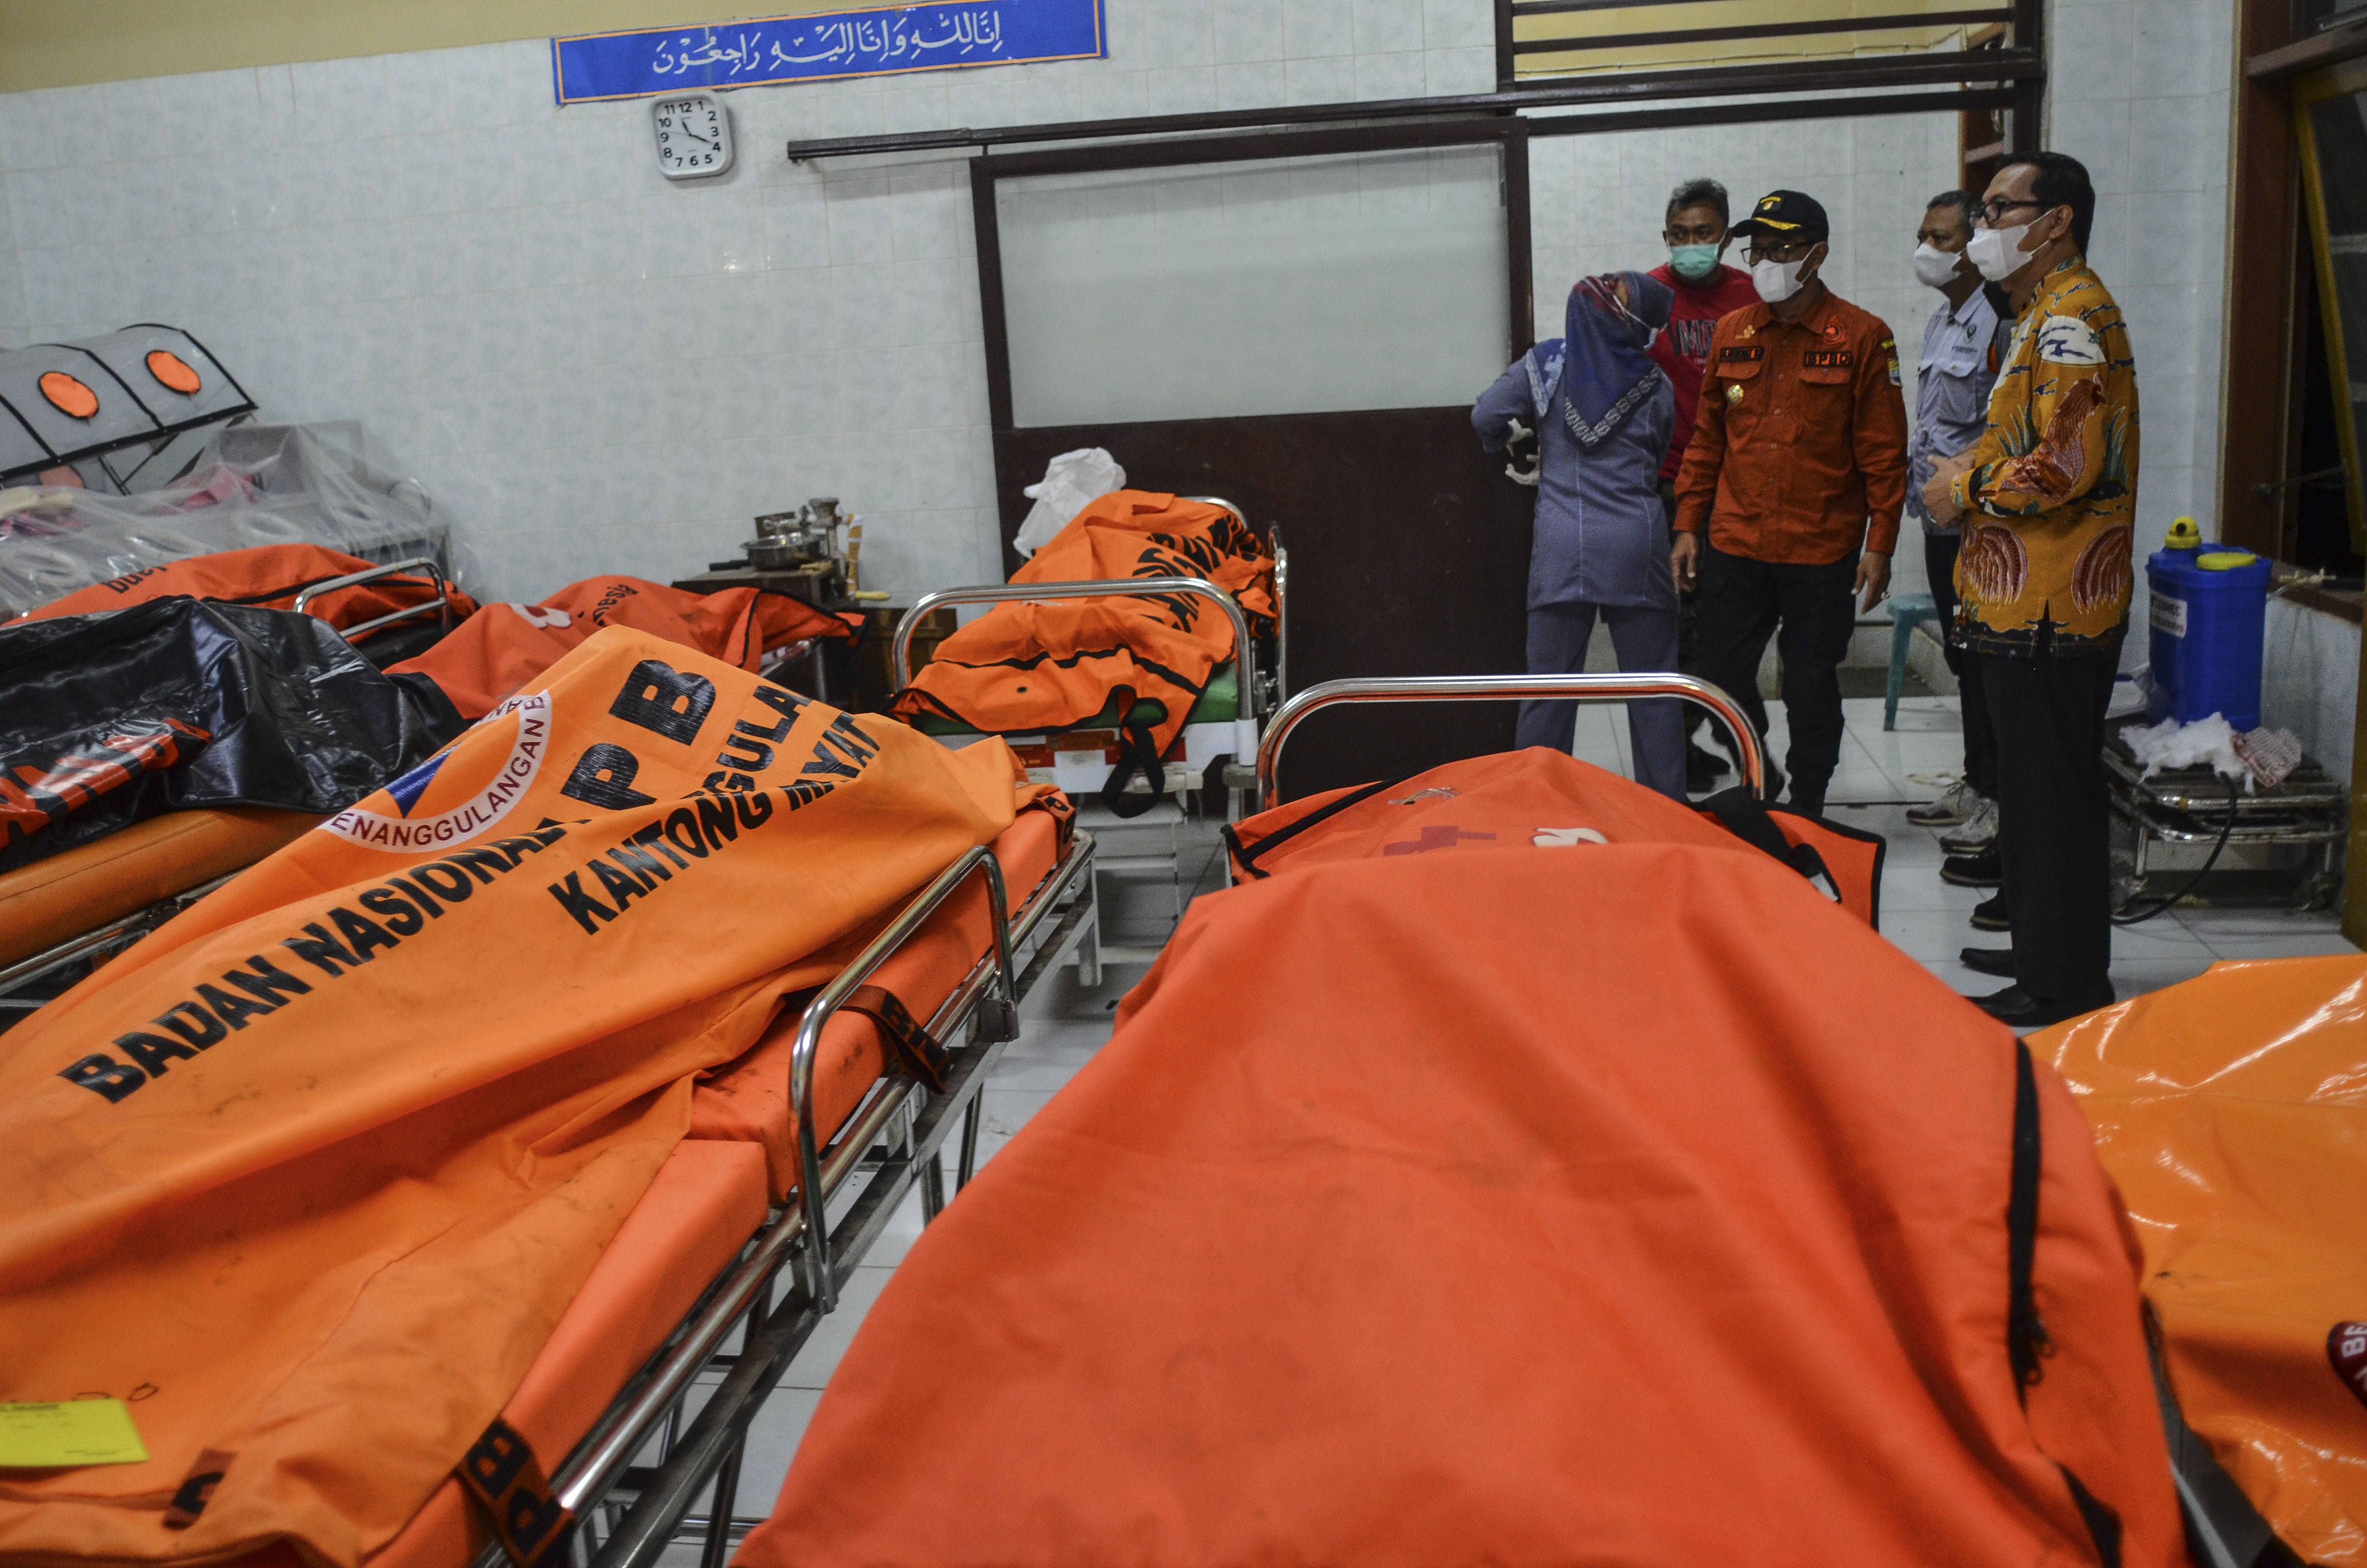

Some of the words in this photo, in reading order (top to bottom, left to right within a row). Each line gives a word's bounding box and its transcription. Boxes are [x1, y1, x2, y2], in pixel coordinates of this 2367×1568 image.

[664, 104, 676, 115] 11
[679, 101, 693, 113] 12
[698, 100, 704, 111] 1
[708, 110, 717, 121] 2
[658, 117, 672, 128] 10
[710, 126, 719, 137] 3
[660, 132, 669, 143] 9
[712, 141, 721, 152] 4
[663, 147, 673, 158] 8
[675, 156, 683, 167] 7
[690, 155, 699, 166] 6
[704, 153, 713, 164] 5
[330, 718, 545, 846] ENANGGULANGAN
[547, 788, 773, 935] KANTONG
[56, 954, 314, 1104] BADAN
[278, 827, 568, 978] NASIONAL
[467, 1418, 563, 1555] PB
